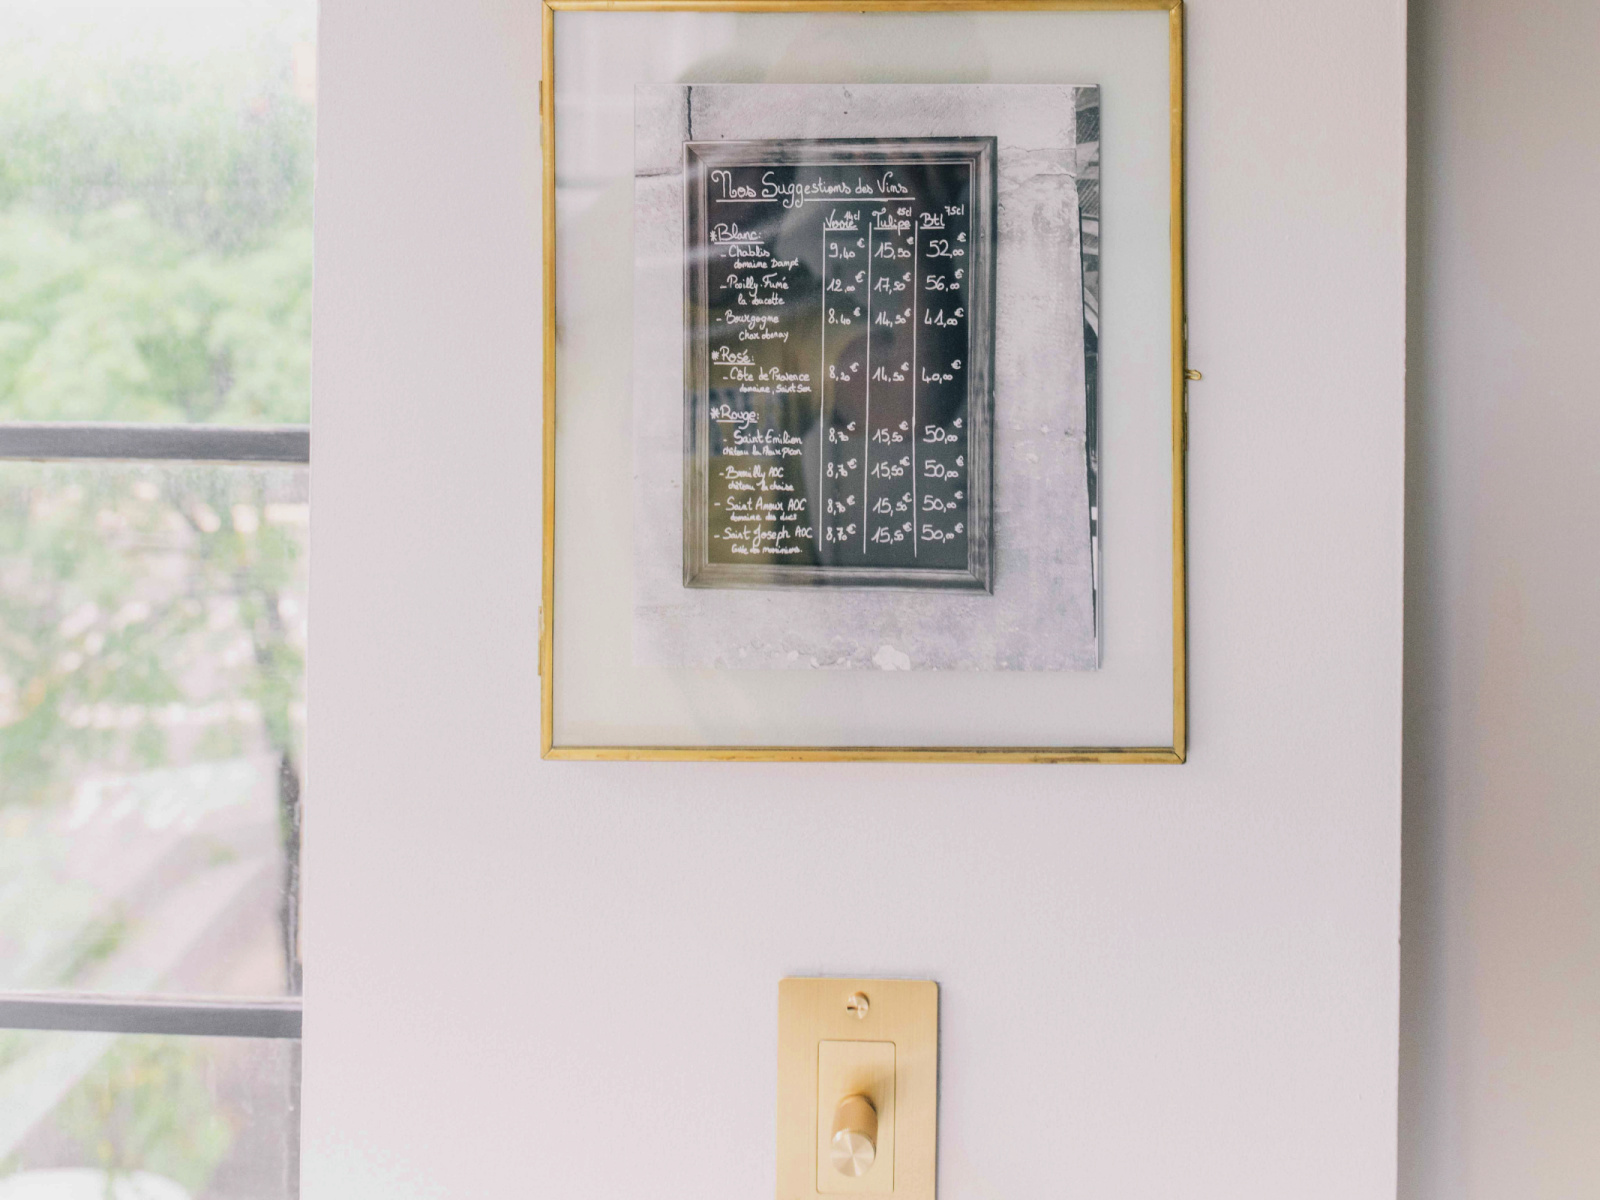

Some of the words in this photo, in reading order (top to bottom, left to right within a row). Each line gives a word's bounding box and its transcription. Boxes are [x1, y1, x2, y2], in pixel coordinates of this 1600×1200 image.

[711, 170, 757, 198] Nos
[761, 171, 851, 208] Suggestions
[855, 177, 873, 194] des
[877, 171, 909, 194] Vins
[872, 207, 911, 236] Tulipe
[920, 212, 946, 227] Btl
[944, 204, 965, 216] 75cl
[734, 259, 768, 270] domaine
[771, 257, 799, 271] Dampt
[738, 293, 747, 305] la
[730, 366, 754, 381] Côte
[758, 366, 769, 381] de
[769, 367, 810, 381] Provence
[733, 429, 763, 445] Saint
[765, 429, 802, 445] Emilion
[768, 465, 784, 478] AOC
[725, 496, 753, 511] Saint
[787, 498, 807, 511] AOC
[723, 525, 751, 540] Saint
[753, 523, 791, 547] Joseph
[795, 525, 813, 538] AOC
